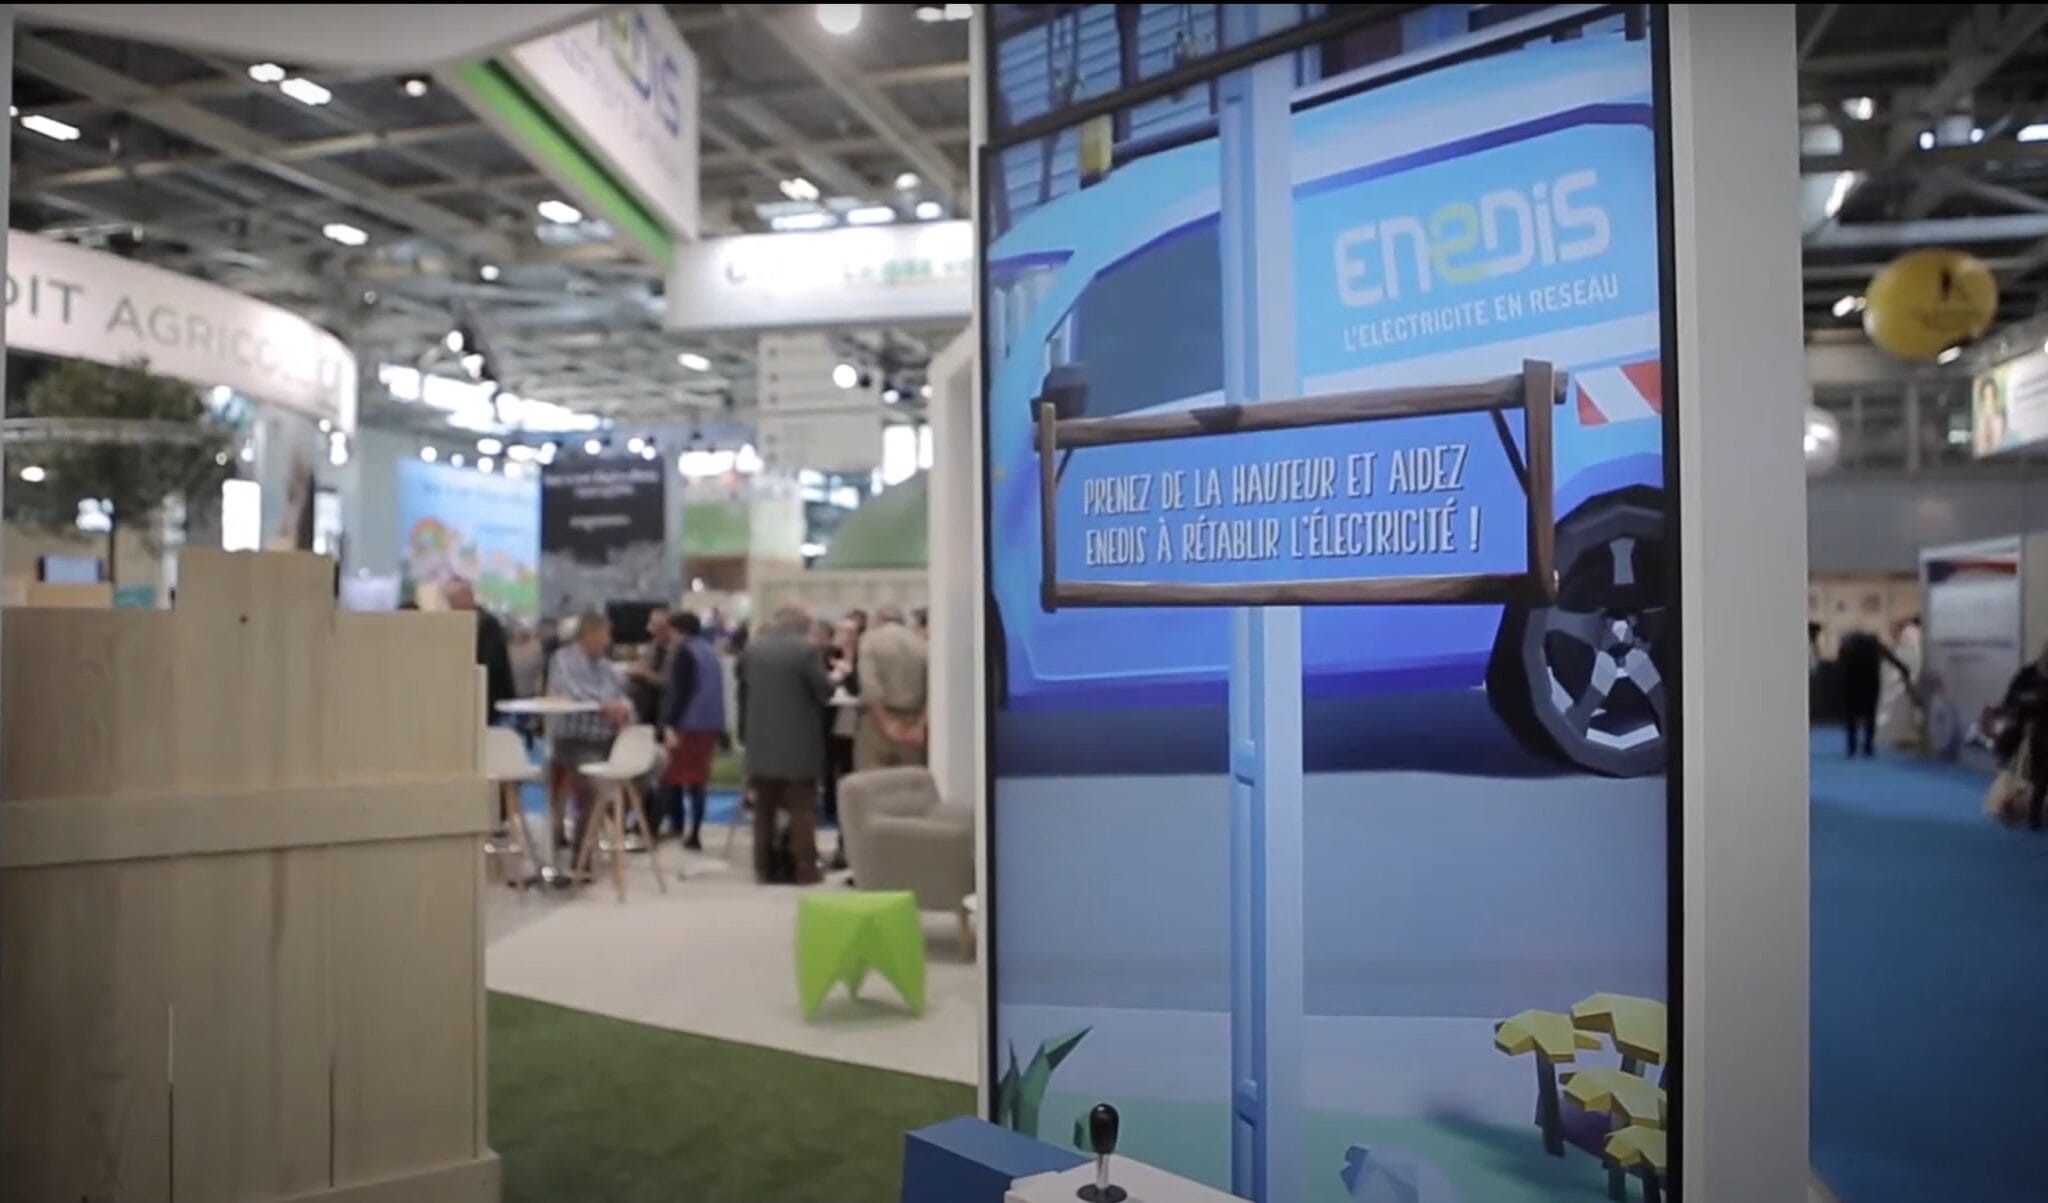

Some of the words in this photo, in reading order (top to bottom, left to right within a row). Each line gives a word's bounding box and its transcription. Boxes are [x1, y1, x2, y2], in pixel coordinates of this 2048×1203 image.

[1343, 298, 1488, 352] L'ELECTRICITE
[1494, 294, 1523, 322] EN
[1529, 273, 1619, 314] RESEAU
[1083, 473, 1153, 516] PRENEZ
[1160, 470, 1186, 511] DE
[1193, 467, 1223, 509] LA
[1232, 456, 1338, 506] HAUTEUR
[1347, 451, 1378, 498] ET
[1388, 443, 1469, 495] AIDEZ
[1085, 525, 1148, 567] ENEDIS
[1156, 516, 1174, 564] À
[1181, 513, 1282, 562] RÉTABLIR
[1290, 496, 1460, 559] L'ÉLECTRICITÉ
[1469, 504, 1482, 553] !
